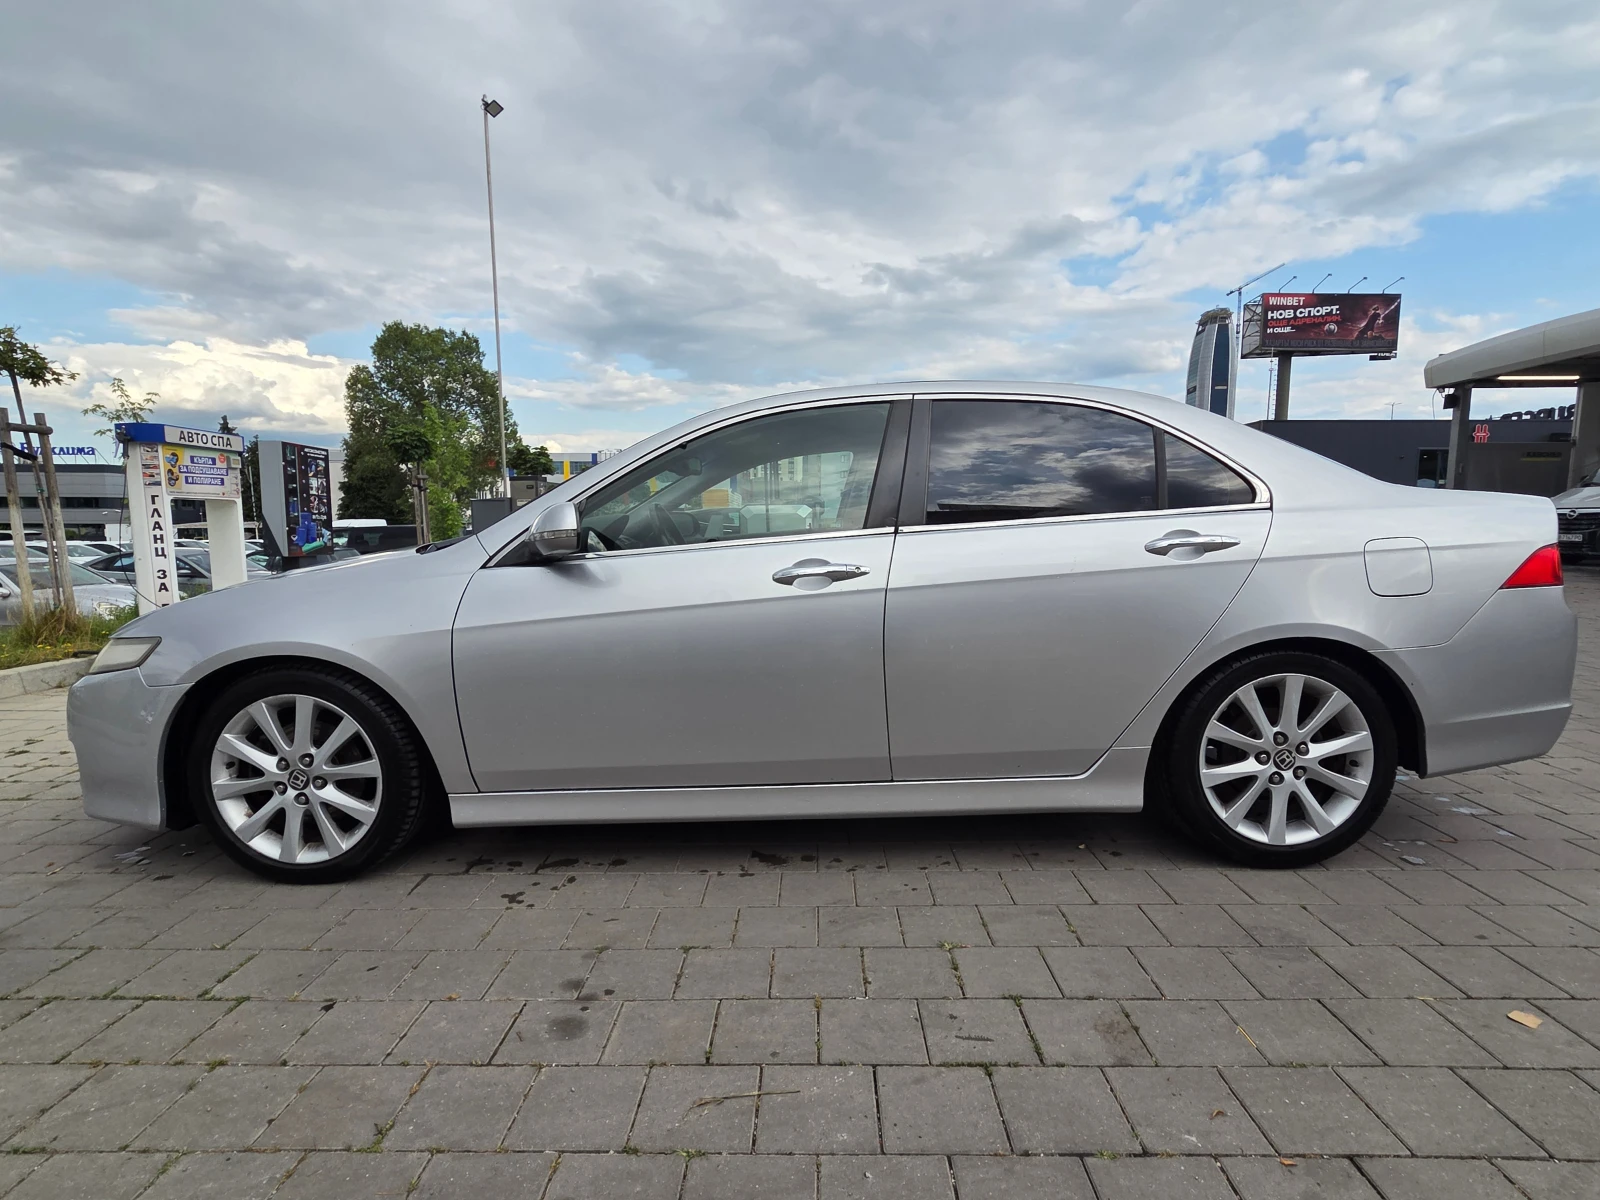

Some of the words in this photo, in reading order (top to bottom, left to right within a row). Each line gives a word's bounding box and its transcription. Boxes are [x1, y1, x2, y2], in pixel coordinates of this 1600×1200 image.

[1268, 296, 1305, 306] WINBET
[1267, 309, 1294, 319] НОВ
[1296, 305, 1340, 317] СПОРТ.
[179, 430, 209, 445] АВТО
[211, 434, 232, 448] СПА
[194, 457, 213, 465] КЪРПА
[150, 494, 167, 559] ГЛАНЦ
[156, 569, 169, 592] ЗА
